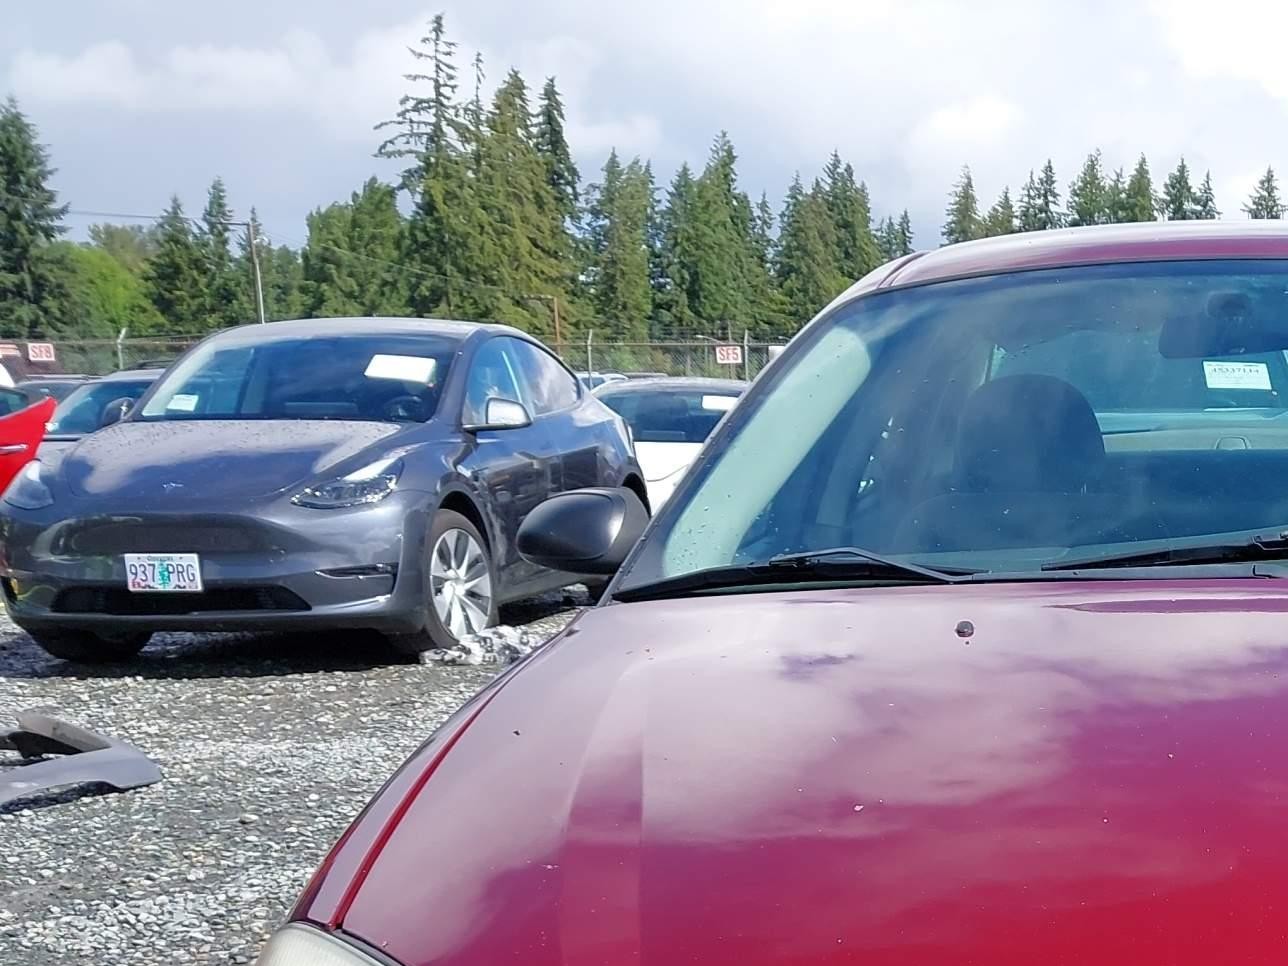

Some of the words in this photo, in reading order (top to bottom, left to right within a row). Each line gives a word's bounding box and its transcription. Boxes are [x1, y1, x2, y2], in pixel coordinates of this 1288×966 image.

[718, 347, 739, 360] SF5
[129, 563, 156, 582] 937
[167, 563, 196, 582] PRG
